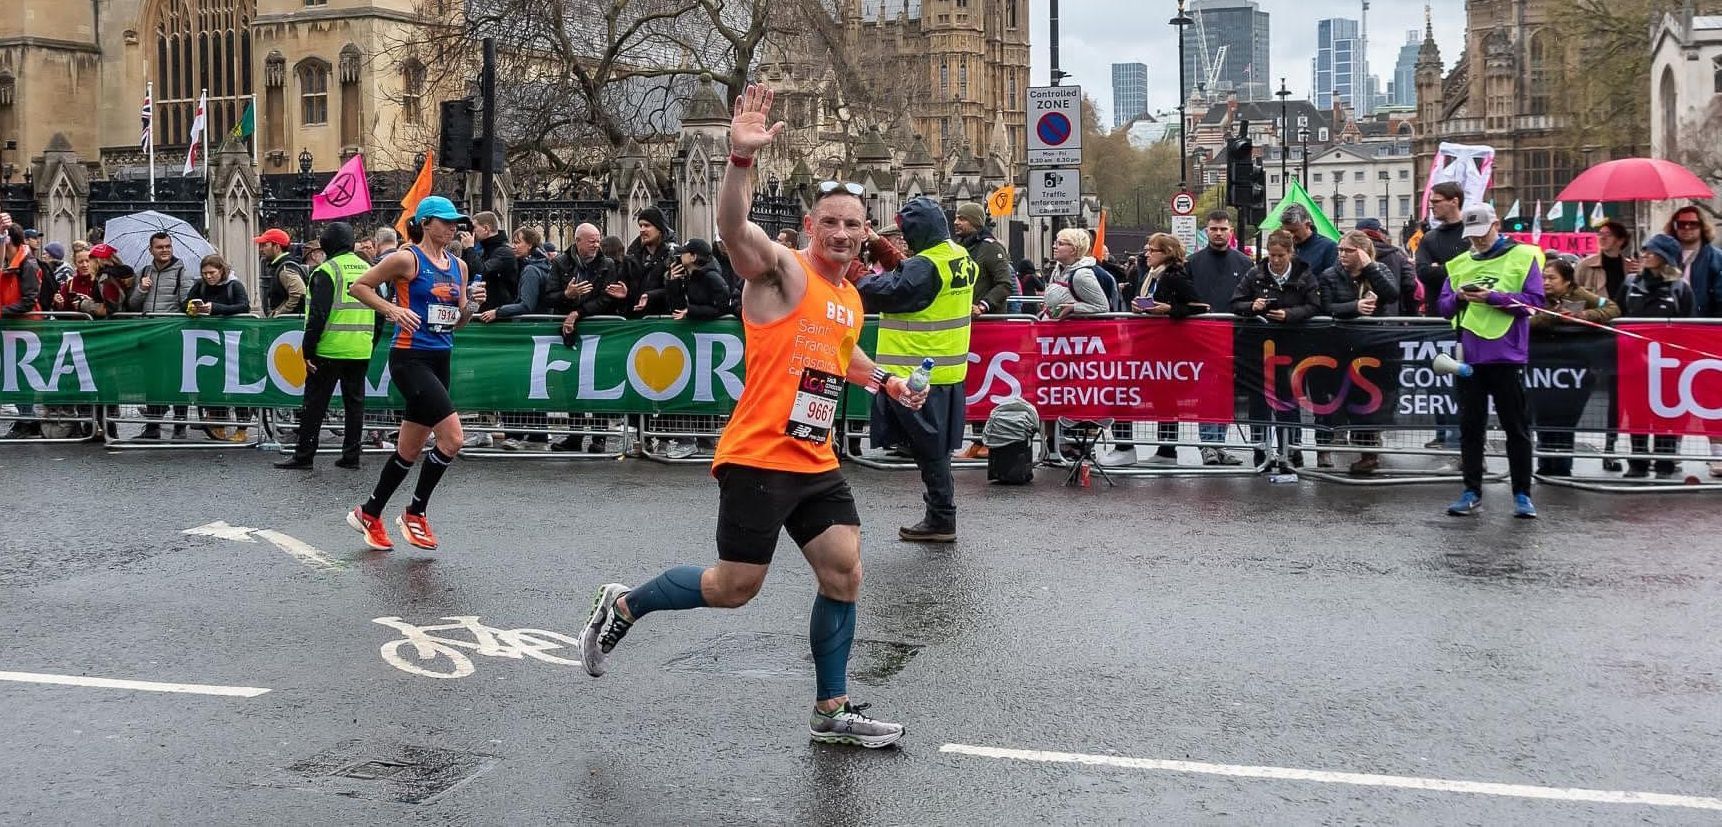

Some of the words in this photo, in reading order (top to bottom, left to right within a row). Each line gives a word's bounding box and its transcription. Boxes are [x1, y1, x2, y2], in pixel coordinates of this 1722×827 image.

[1030, 90, 1077, 98] Controlled
[1037, 100, 1069, 109] ZONE
[437, 308, 456, 321] 7914
[827, 301, 855, 328] BEN
[794, 334, 837, 357] Francis
[1036, 336, 1106, 356] TATA
[1399, 340, 1457, 361] TAT
[528, 332, 744, 402] FLOR
[1036, 360, 1205, 382] CONSULTANCY
[1036, 386, 1142, 406] SERVICES
[807, 401, 834, 424] 9661
